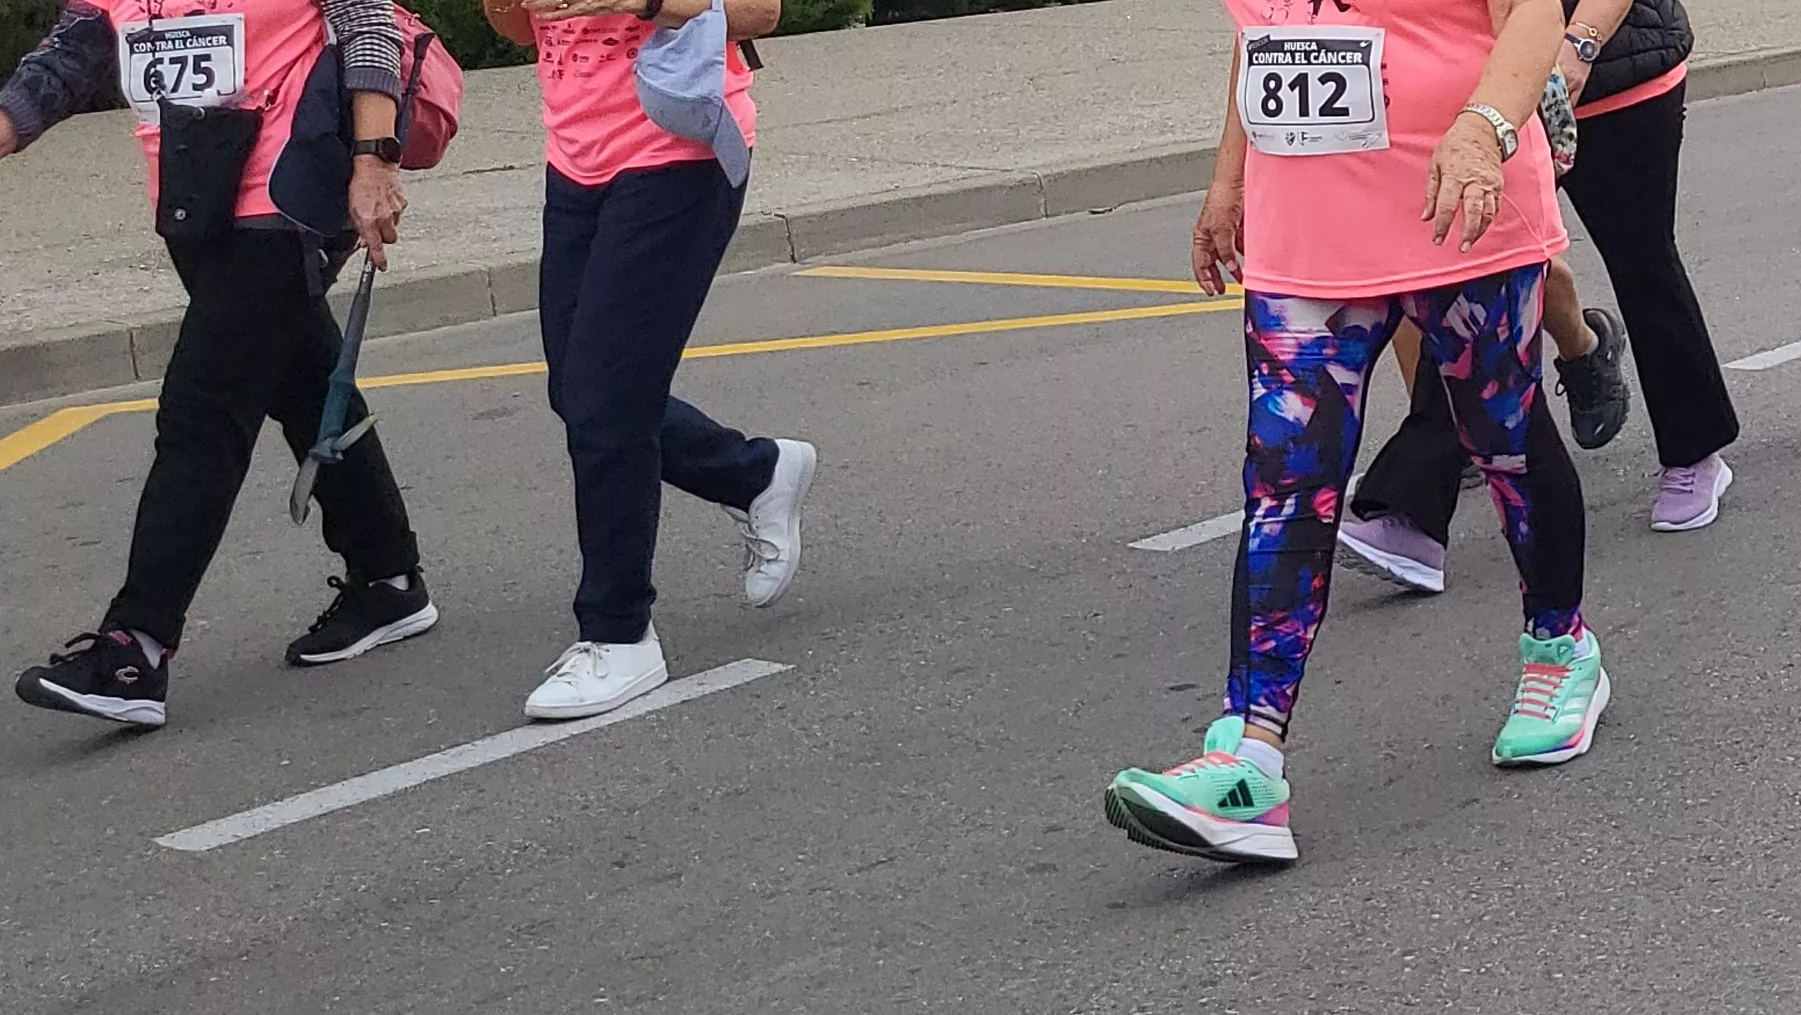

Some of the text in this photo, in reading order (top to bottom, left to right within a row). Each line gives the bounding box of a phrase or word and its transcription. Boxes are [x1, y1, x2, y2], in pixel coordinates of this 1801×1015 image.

[165, 30, 191, 39] HUESCA
[134, 35, 227, 52] CONTRA EL CÁNCER
[1284, 42, 1318, 51] HUESCA
[1252, 49, 1363, 64] CONTRA EL CÁNCER
[144, 54, 215, 95] 675
[1261, 72, 1350, 118] 812
